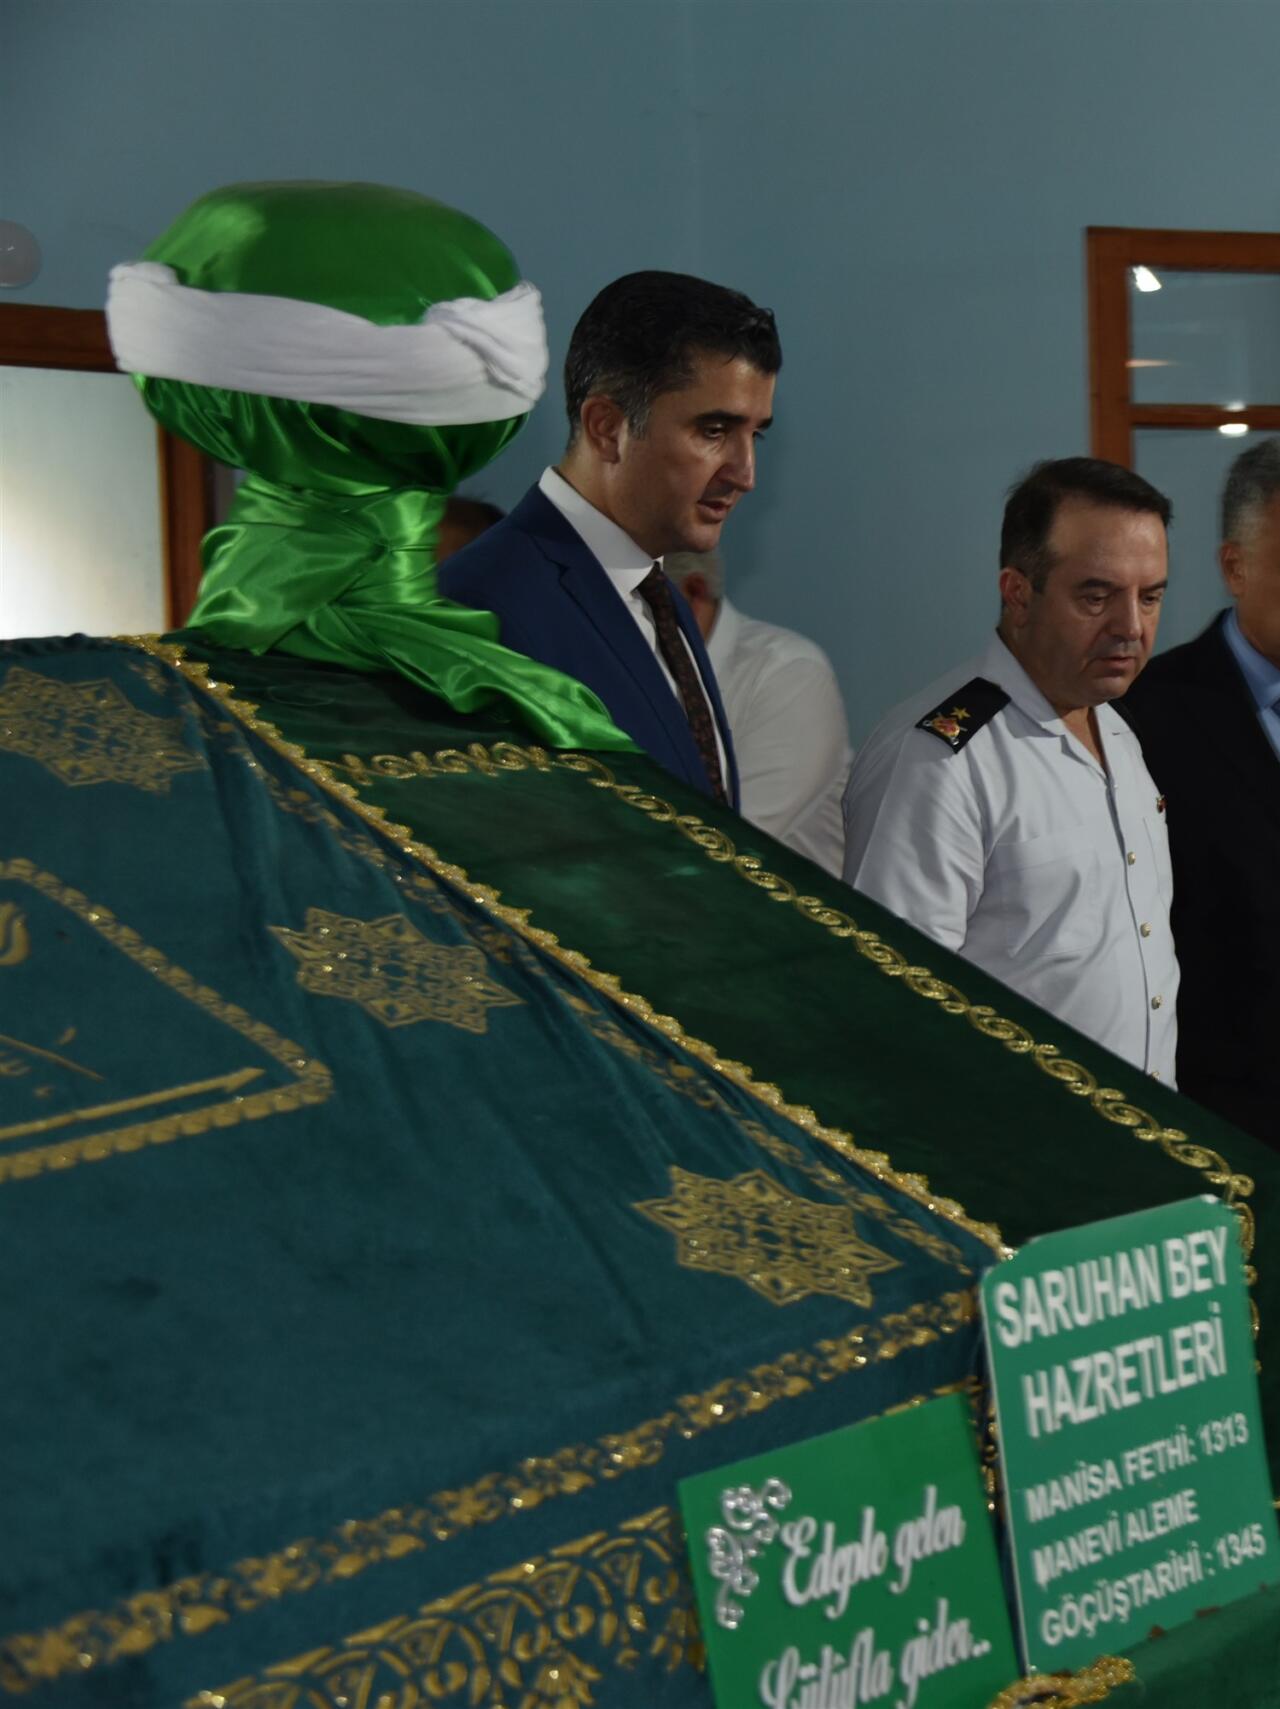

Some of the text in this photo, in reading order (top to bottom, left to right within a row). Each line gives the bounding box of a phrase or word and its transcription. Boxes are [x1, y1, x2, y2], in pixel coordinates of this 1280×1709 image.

[995, 1226, 1228, 1348] SARUHAN BEY
[1021, 1302, 1227, 1438] HAZRETLERİ
[1024, 1413, 1249, 1522] MANİSA FETHİ: 1313
[1033, 1489, 1199, 1588] MANEVİ ALEME
[1216, 1523, 1267, 1569] 1345
